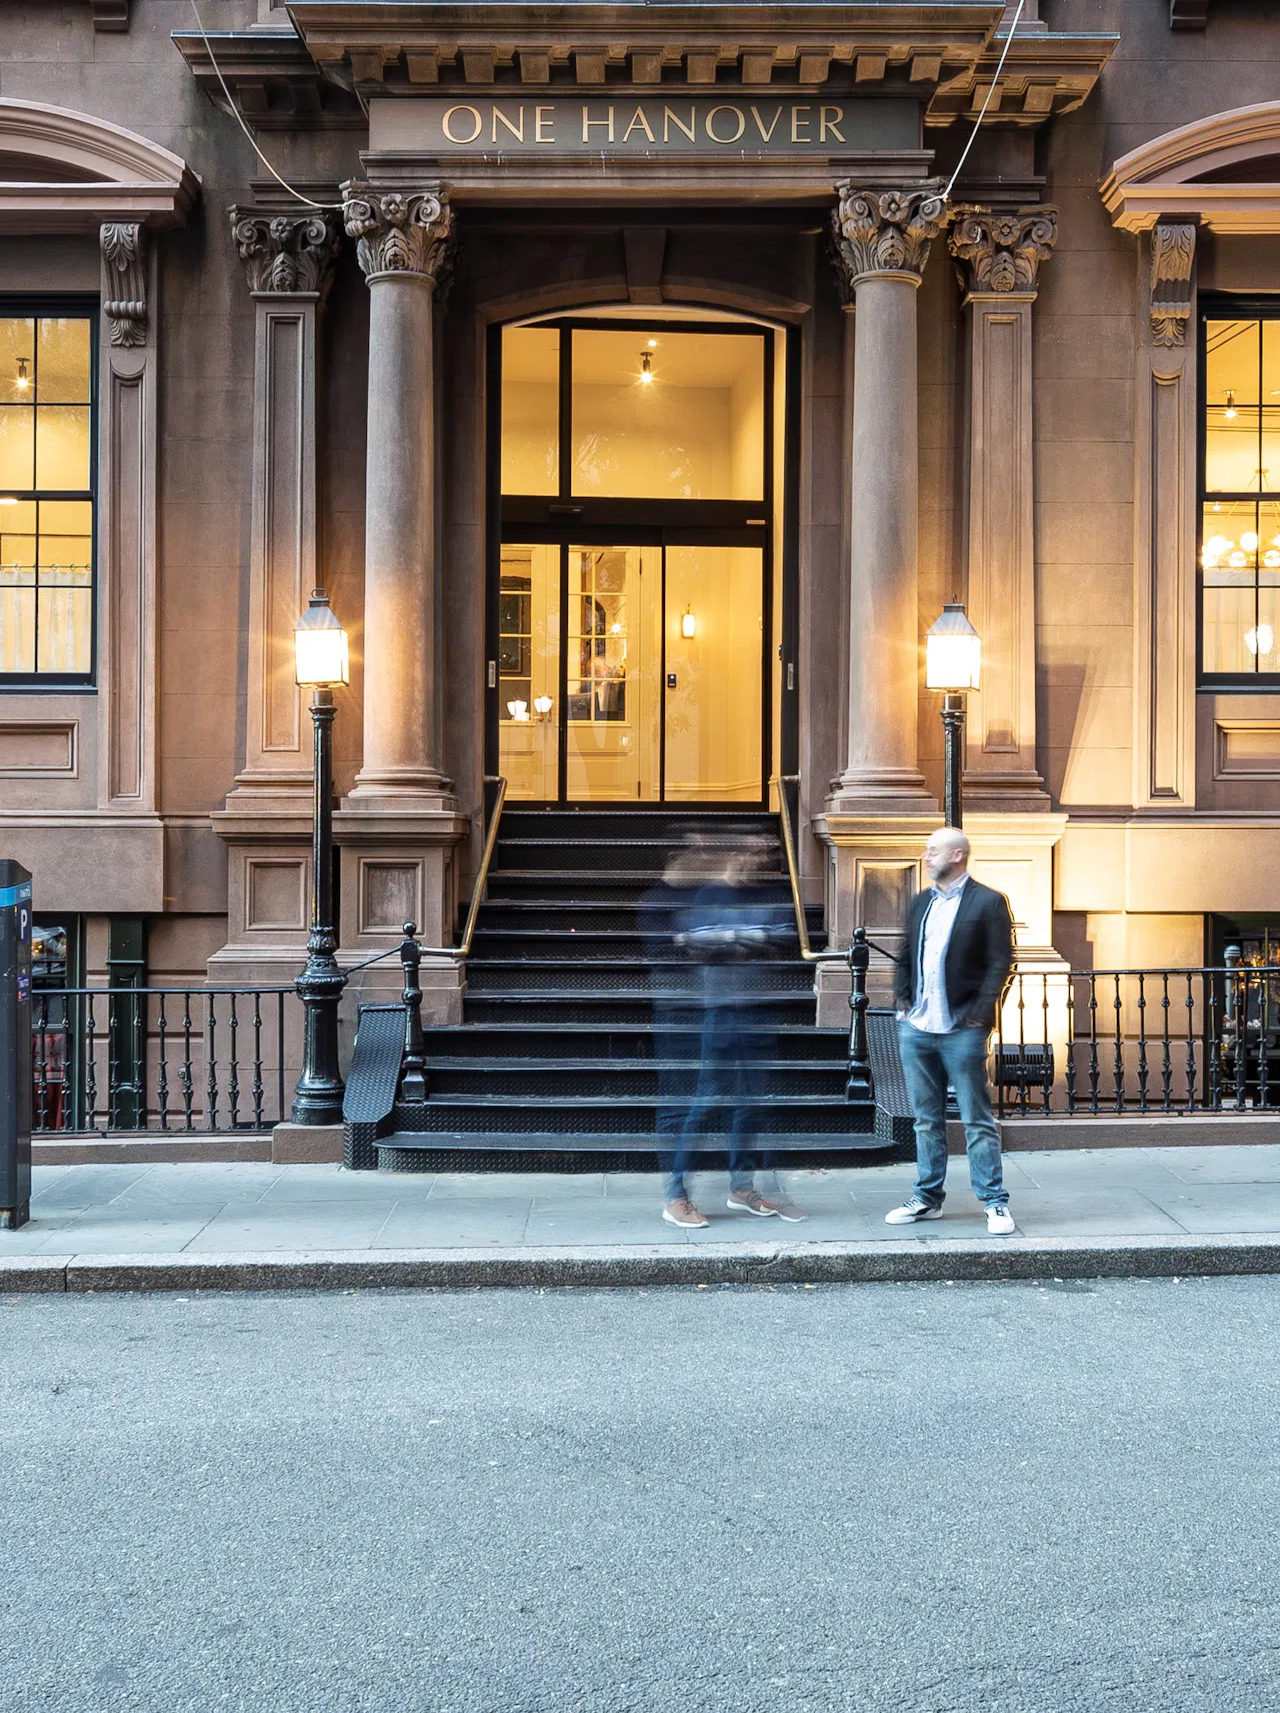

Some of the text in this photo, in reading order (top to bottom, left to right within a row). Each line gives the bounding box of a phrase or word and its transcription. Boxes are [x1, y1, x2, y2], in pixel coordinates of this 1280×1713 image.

[441, 104, 848, 144] ONE HANOVER
[20, 909, 28, 940] P
